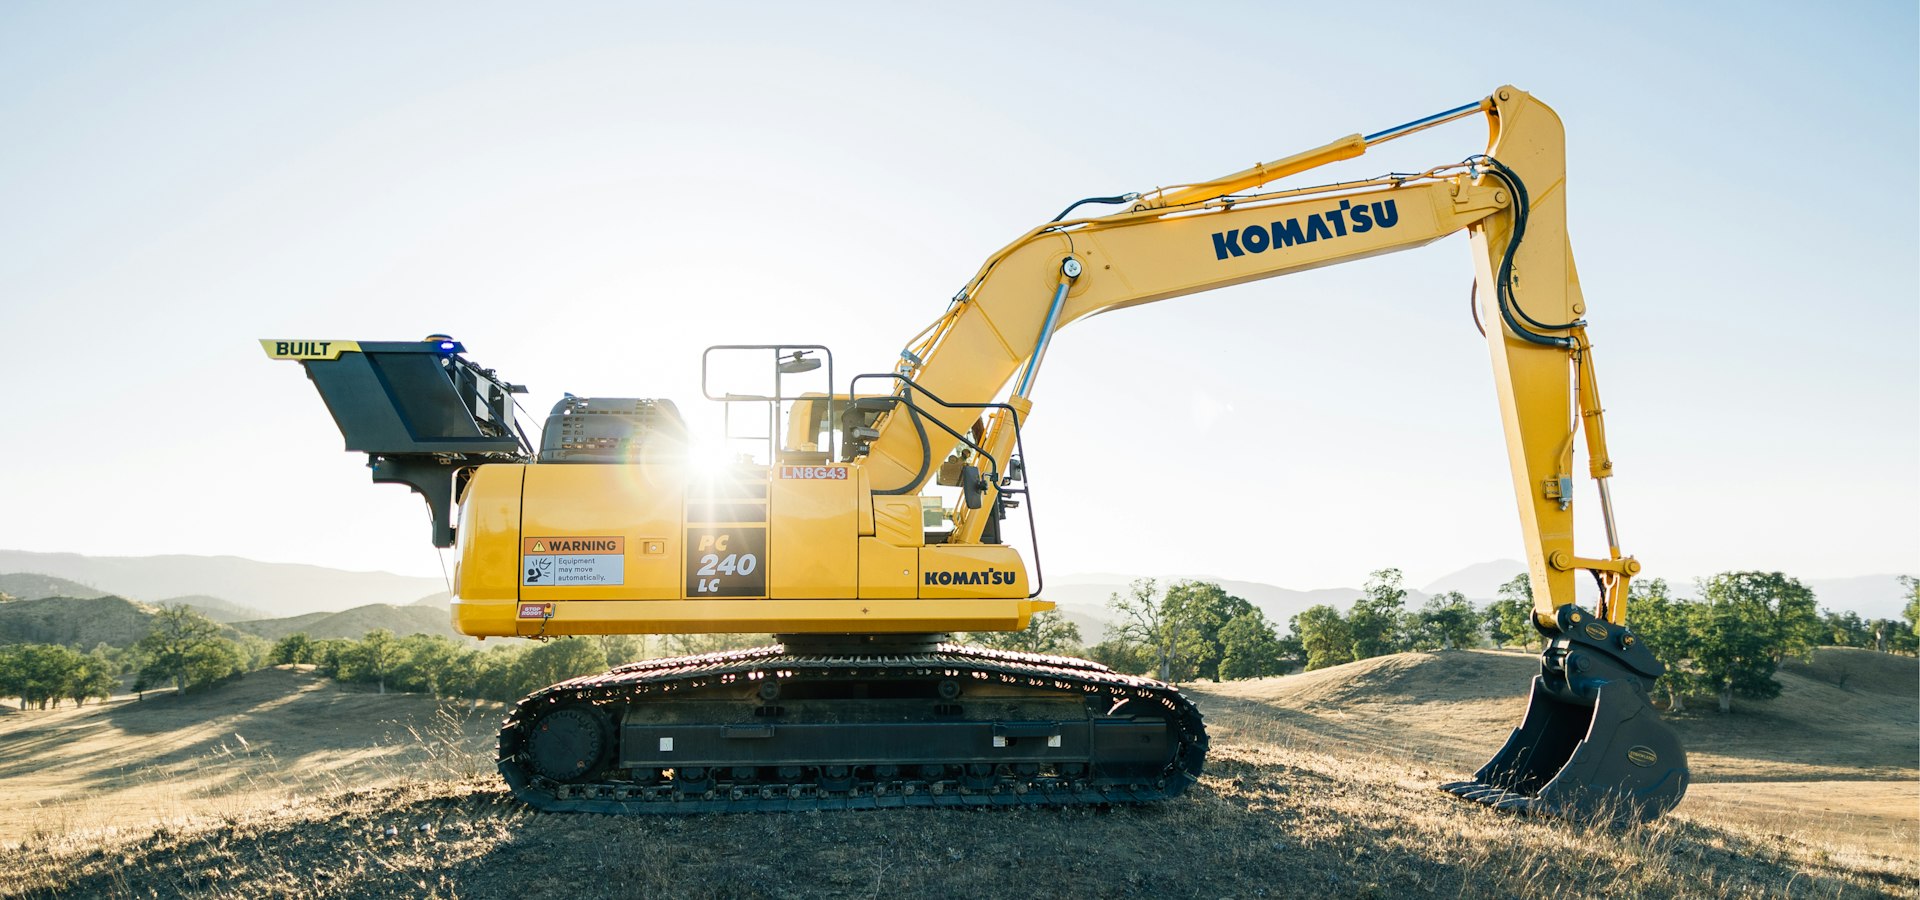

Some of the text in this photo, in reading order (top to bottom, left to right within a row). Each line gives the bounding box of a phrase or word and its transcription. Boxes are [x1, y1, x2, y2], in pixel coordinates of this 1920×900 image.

[1211, 199, 1399, 260] KOMATSU
[276, 341, 331, 356] BUILT
[782, 467, 846, 479] LN8G43
[549, 540, 616, 551] WARNING
[698, 534, 730, 551] PC
[697, 553, 757, 576] 240
[925, 568, 1016, 585] KOMATSU
[697, 578, 720, 593] LC
